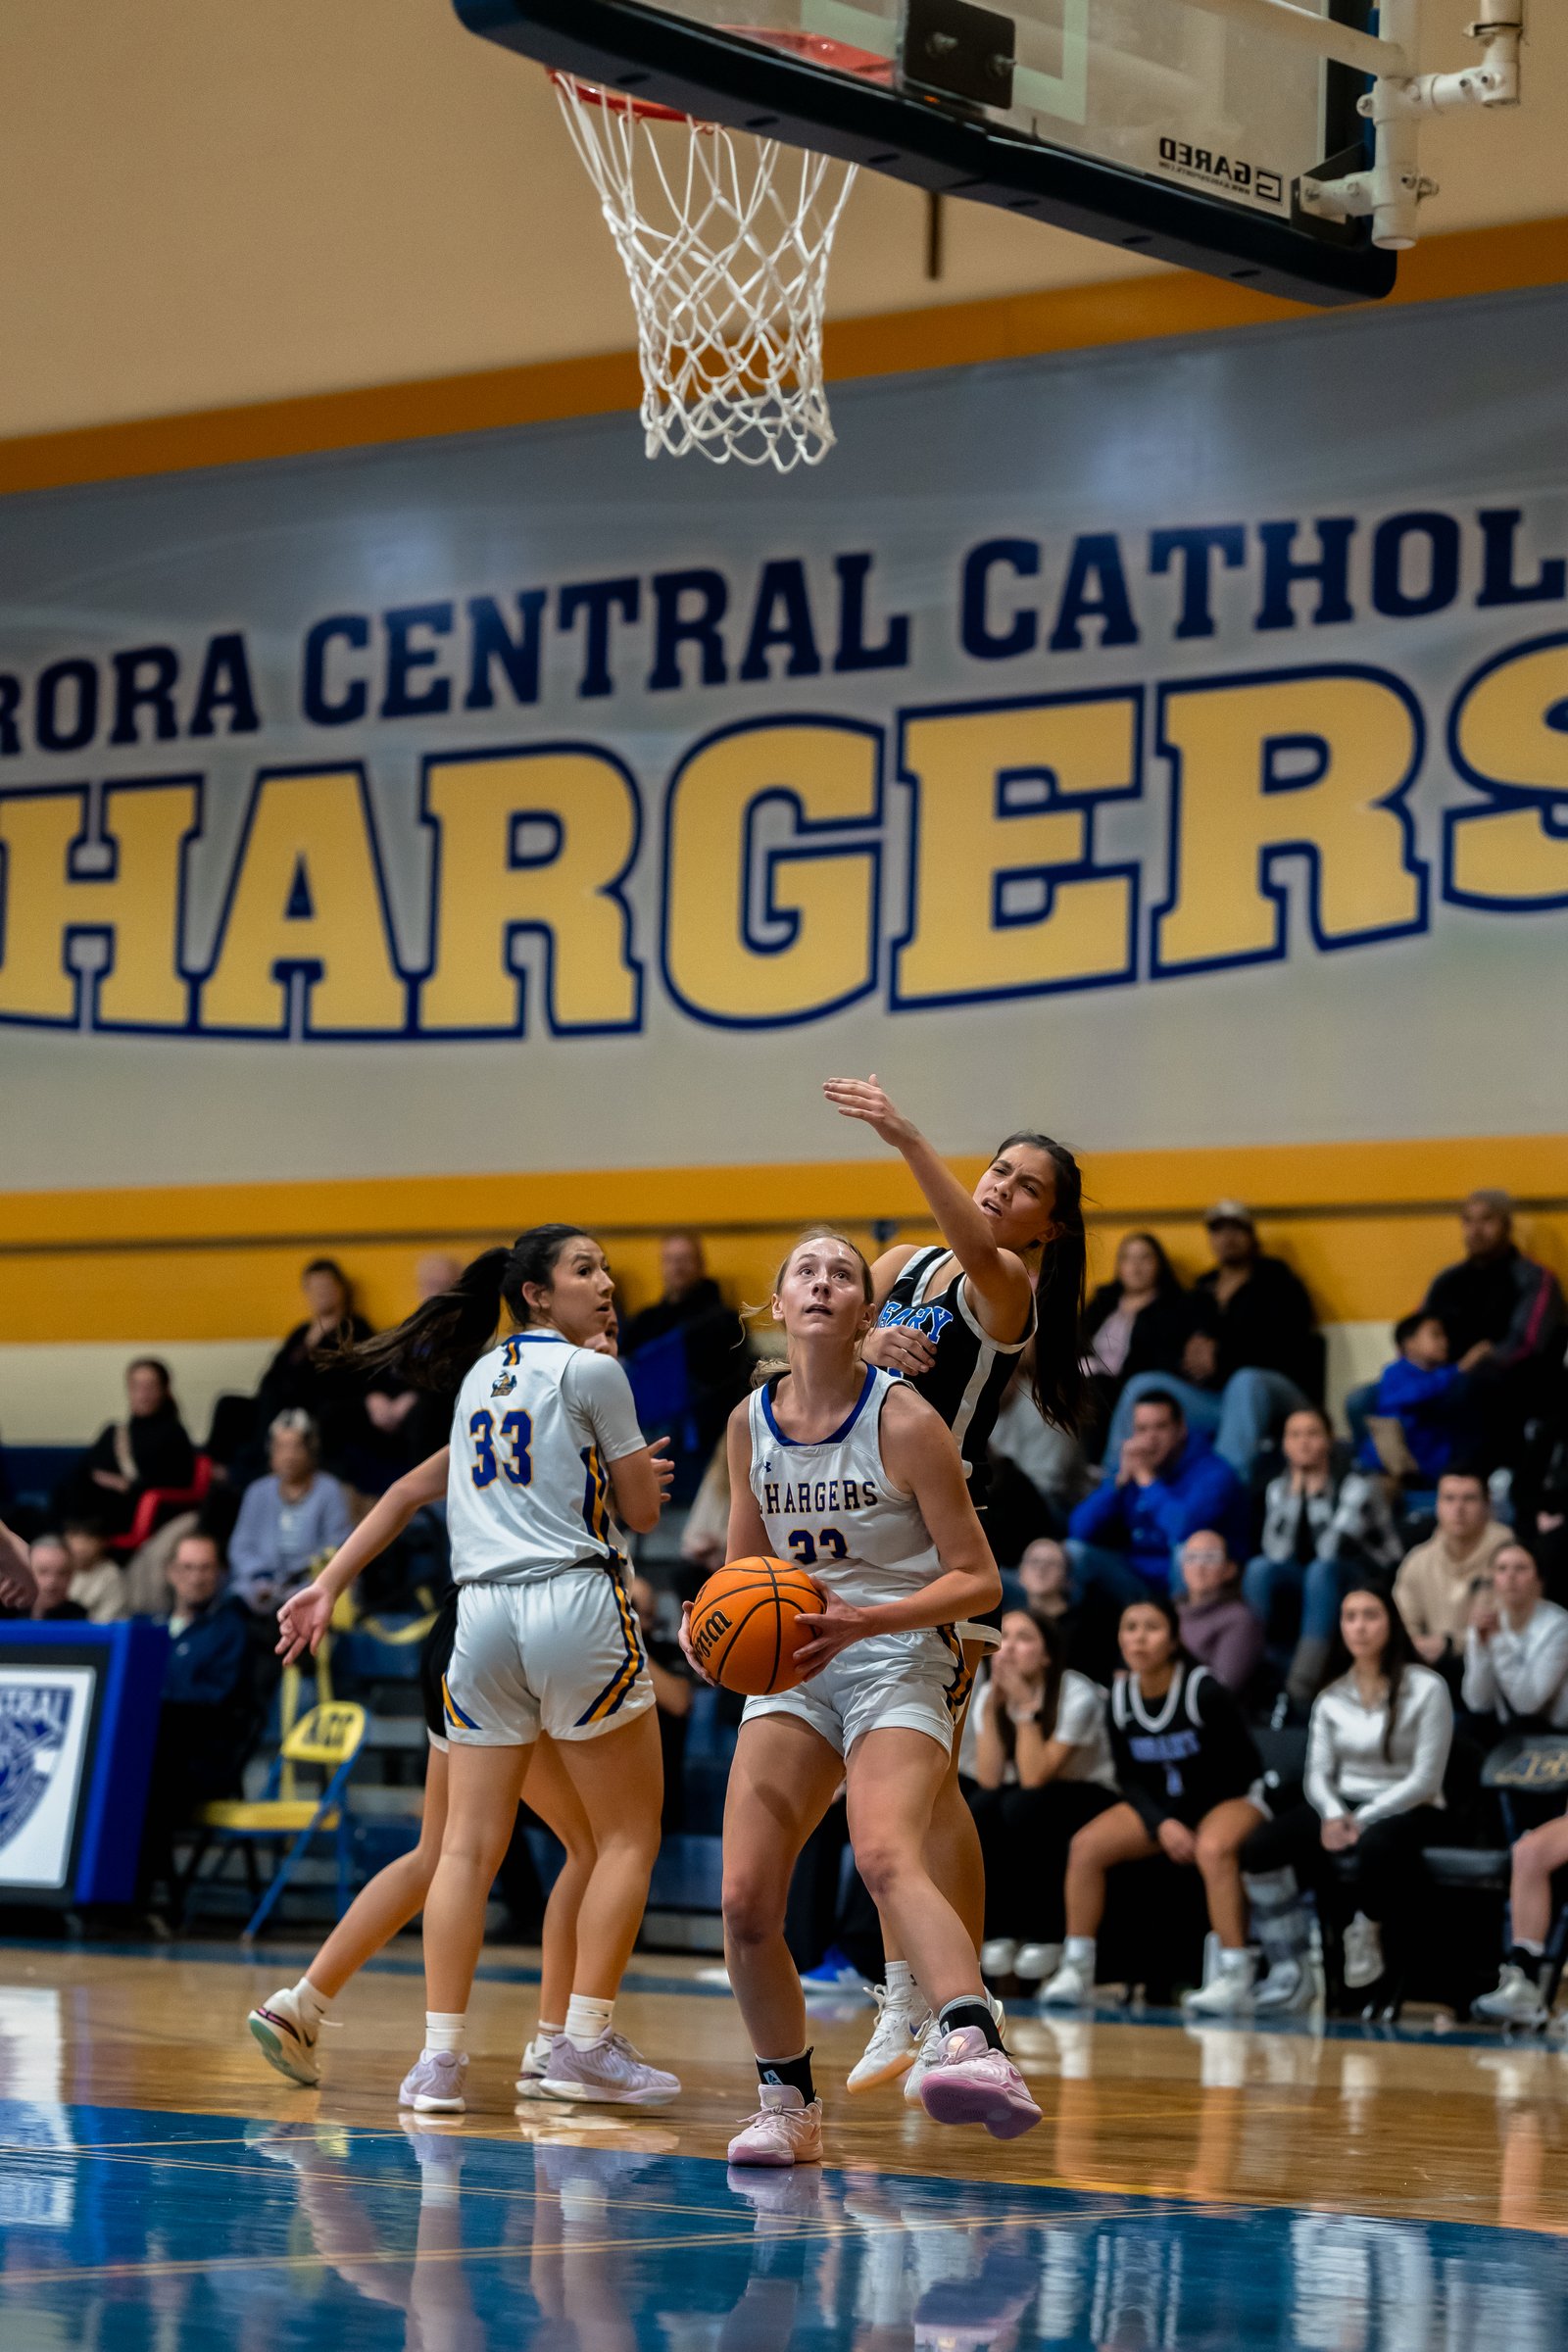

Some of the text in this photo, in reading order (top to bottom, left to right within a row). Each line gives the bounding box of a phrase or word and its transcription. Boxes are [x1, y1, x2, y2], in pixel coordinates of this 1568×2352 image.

[303, 551, 910, 726] CENTRAL
[958, 509, 1566, 661] CATHOL
[469, 1408, 534, 1490] 33
[760, 1480, 878, 1515] HARGERS
